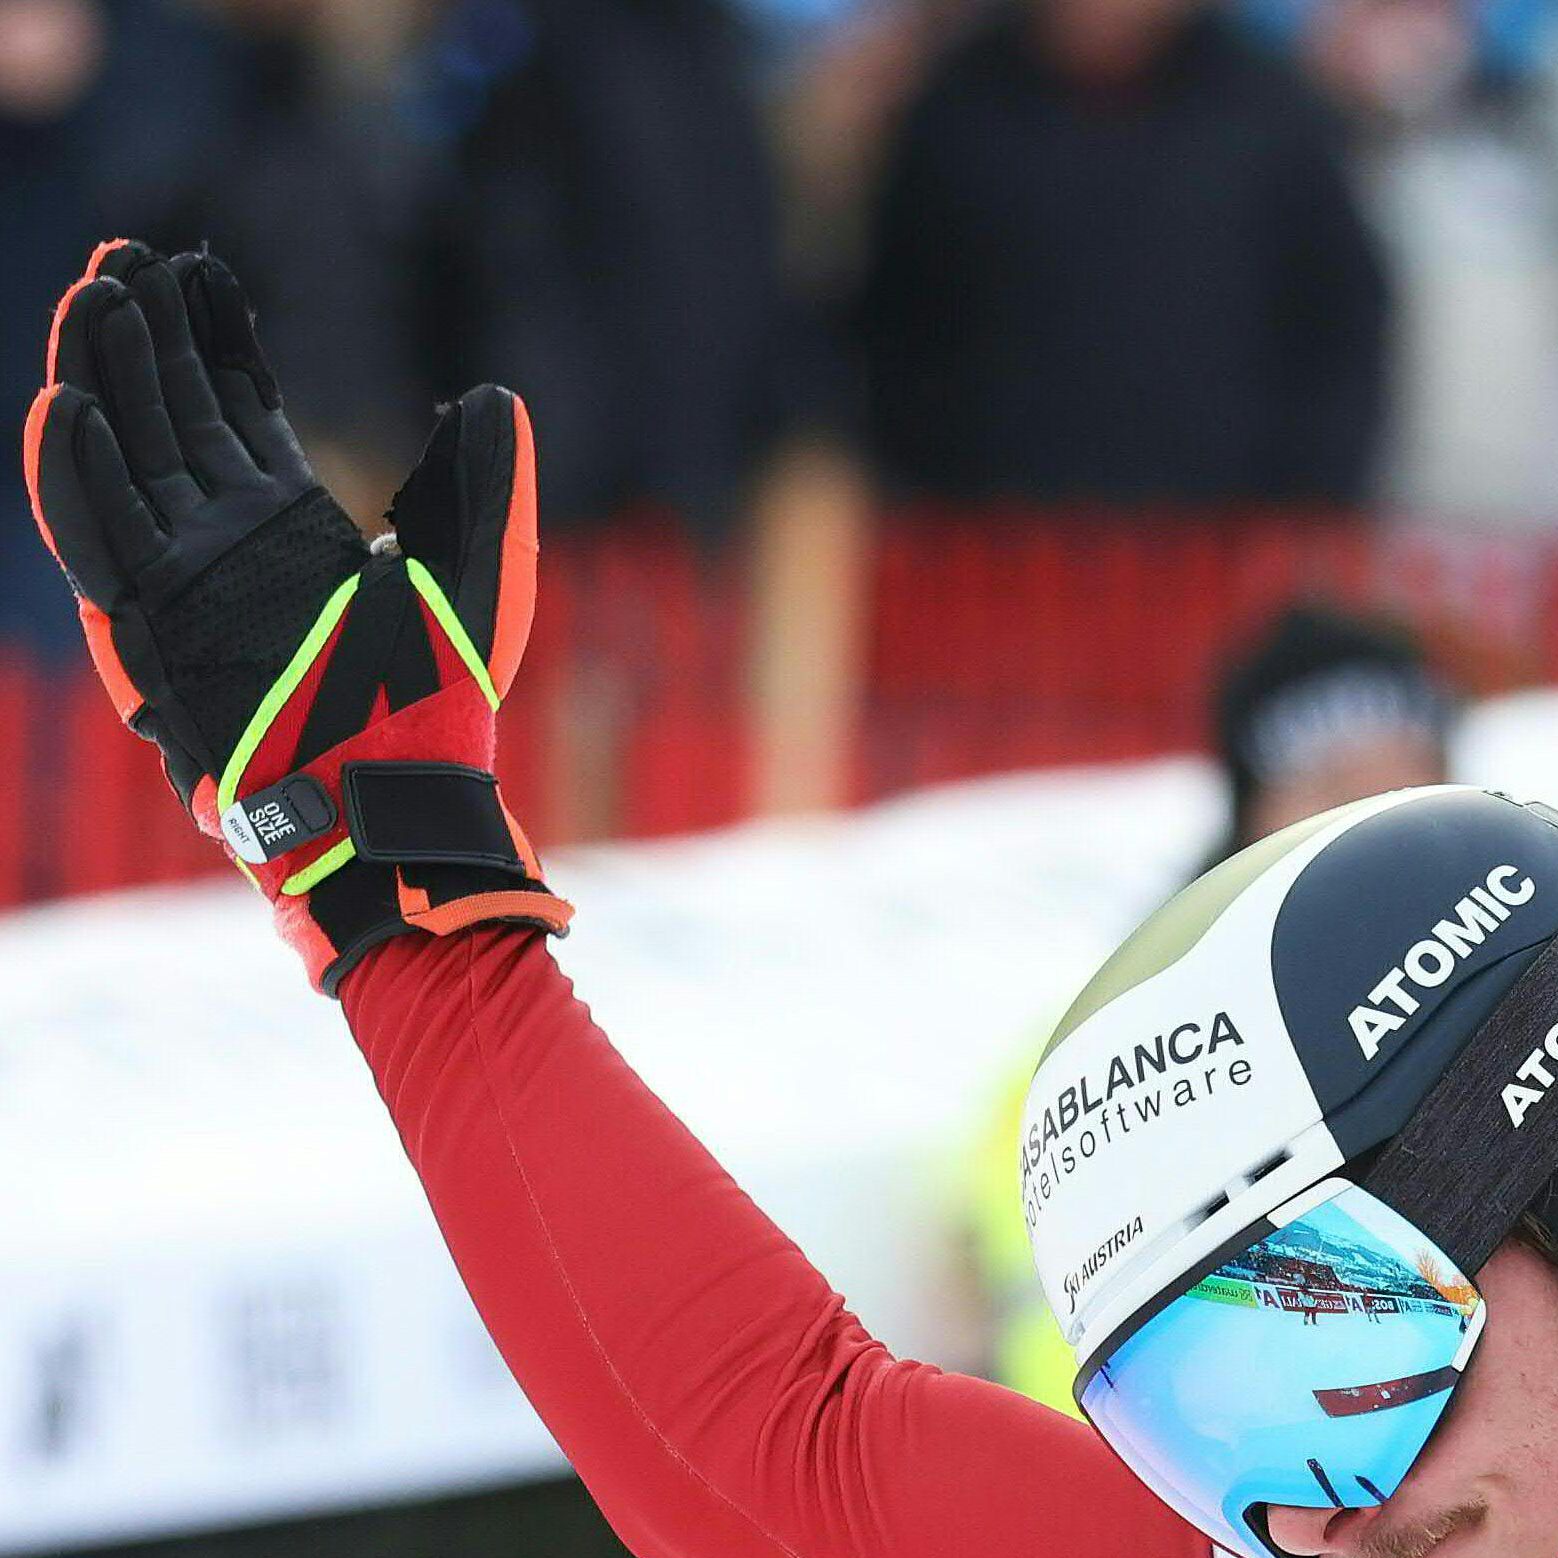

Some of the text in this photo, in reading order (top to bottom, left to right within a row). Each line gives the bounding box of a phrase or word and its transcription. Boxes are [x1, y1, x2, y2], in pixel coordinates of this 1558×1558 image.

[228, 818, 250, 843] RIGHT
[249, 807, 282, 845] SIZE
[264, 802, 296, 836] ONE
[1347, 864, 1536, 1061] ATOMIC
[1020, 1011, 1245, 1203] ASABLANCA
[1024, 1058, 1253, 1236] otelsoftware
[1082, 1215, 1144, 1287] AUSTRIA
